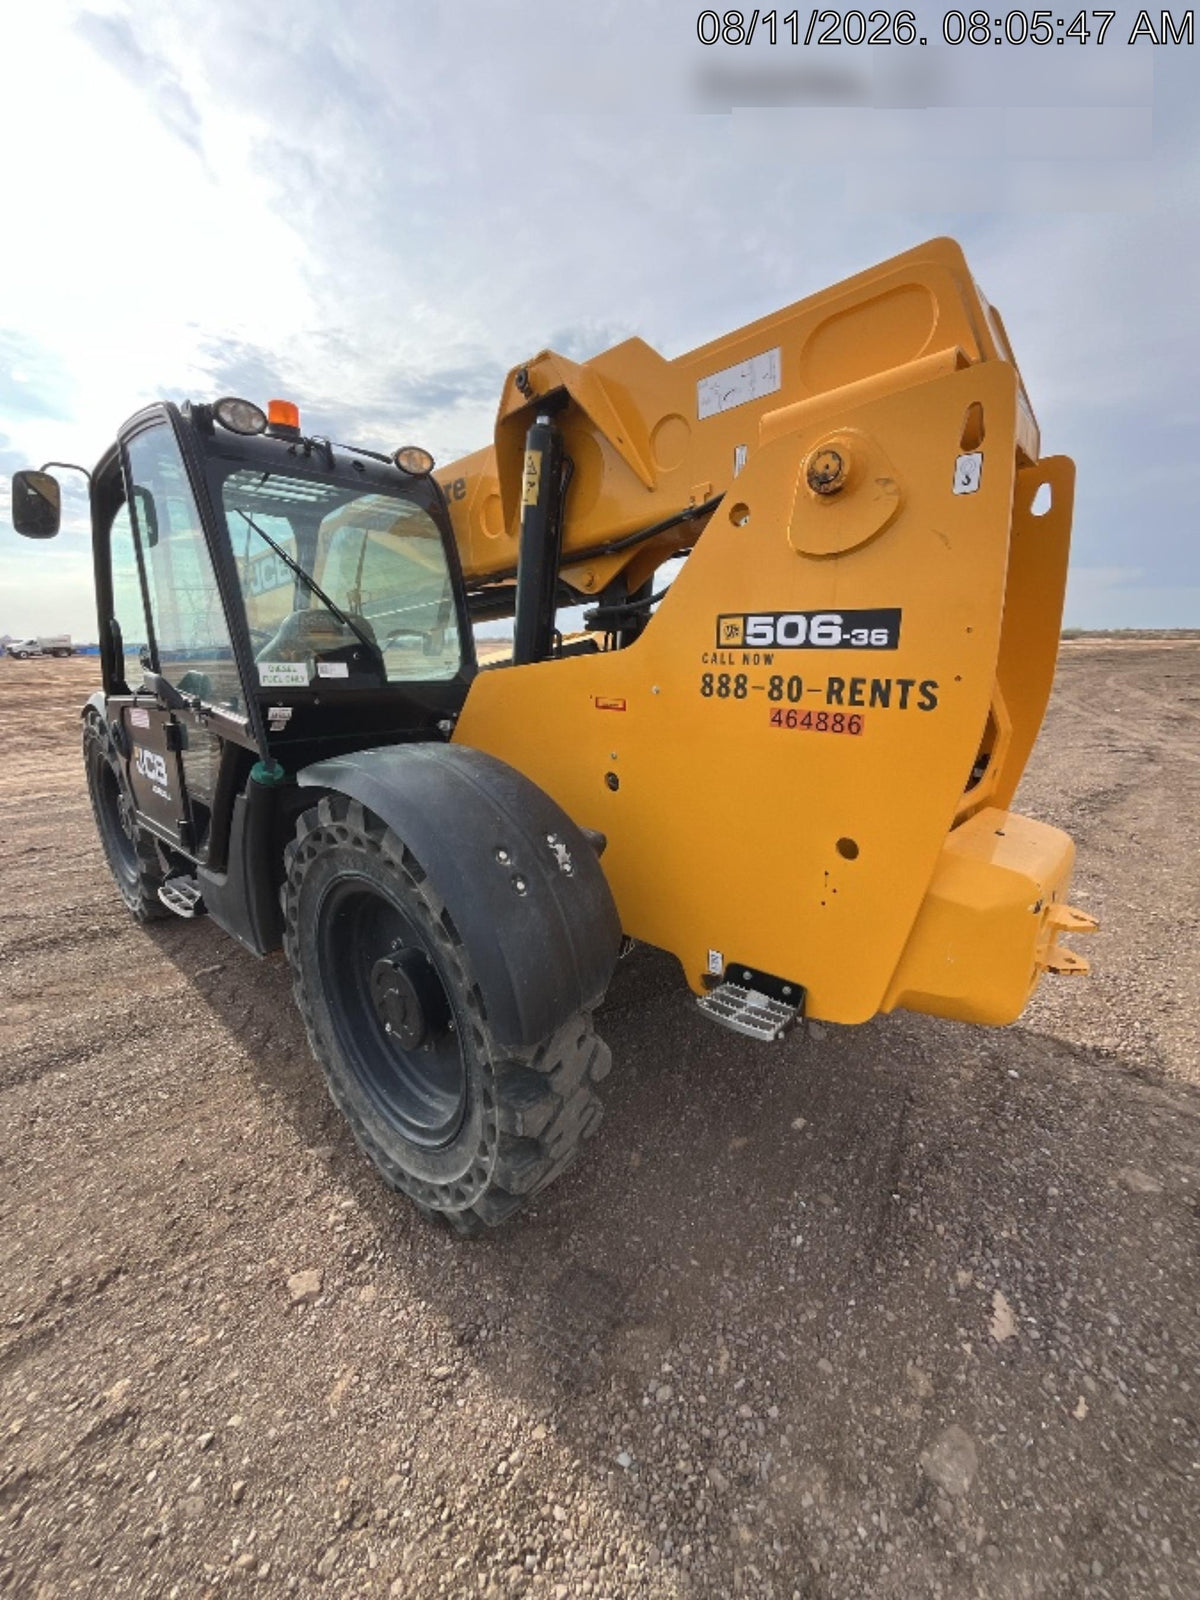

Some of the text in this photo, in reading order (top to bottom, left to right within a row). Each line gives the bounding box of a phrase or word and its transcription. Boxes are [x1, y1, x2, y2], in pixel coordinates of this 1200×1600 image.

[745, 614, 889, 646] 506-36
[701, 652, 775, 666] CALL NOW
[700, 673, 939, 712] 888-80-RENTS
[770, 708, 862, 736] 464886
